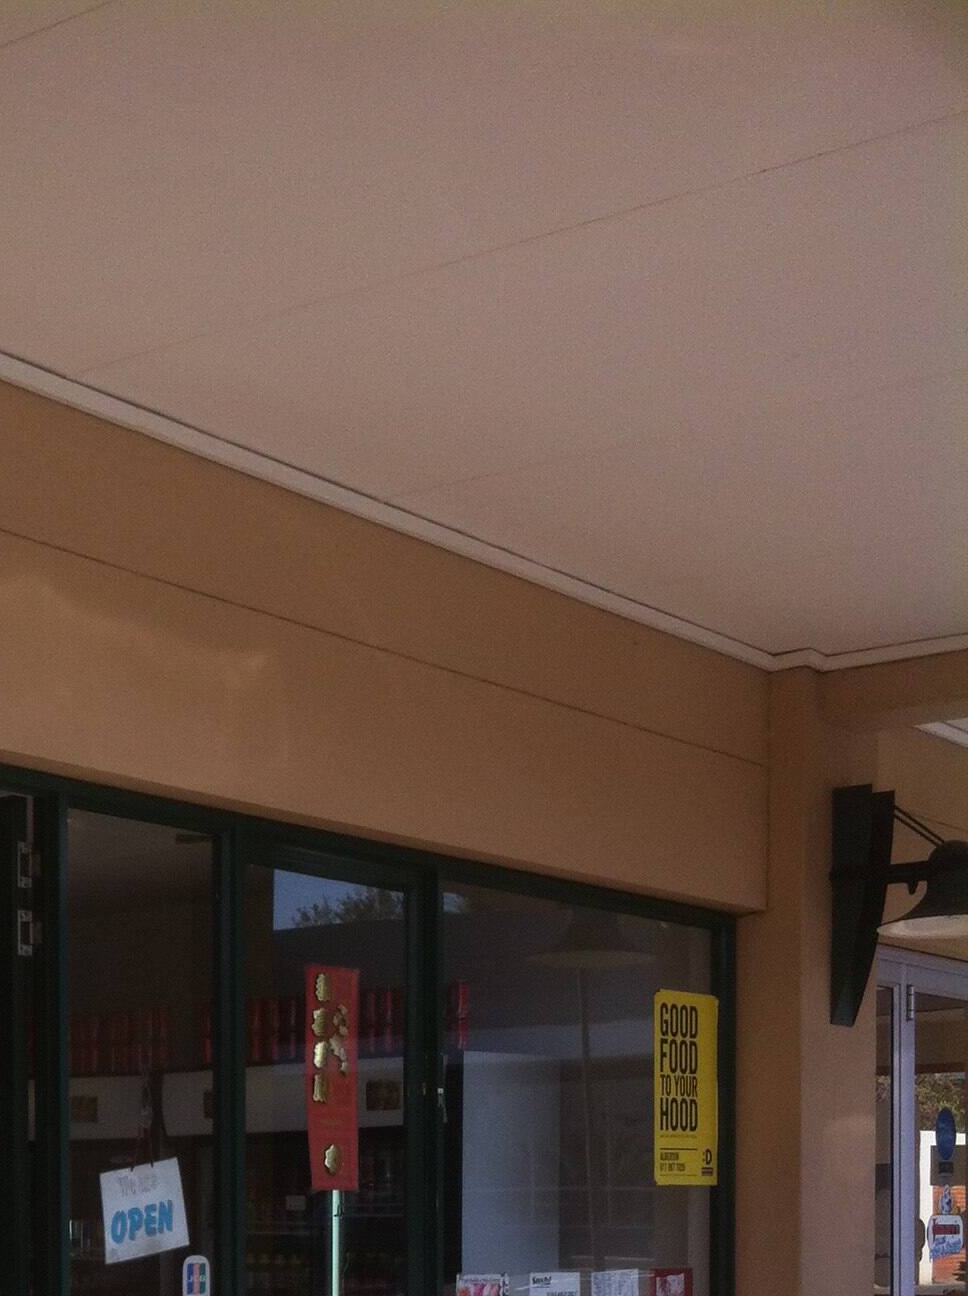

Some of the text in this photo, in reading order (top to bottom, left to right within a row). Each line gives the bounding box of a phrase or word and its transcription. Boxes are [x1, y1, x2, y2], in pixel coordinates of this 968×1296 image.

[660, 1002, 699, 1040] GOOD
[660, 1038, 699, 1075] FOOD
[660, 1074, 698, 1098] TO YOUR
[660, 1097, 699, 1132] HOOD
[111, 1199, 174, 1245] OPEN
